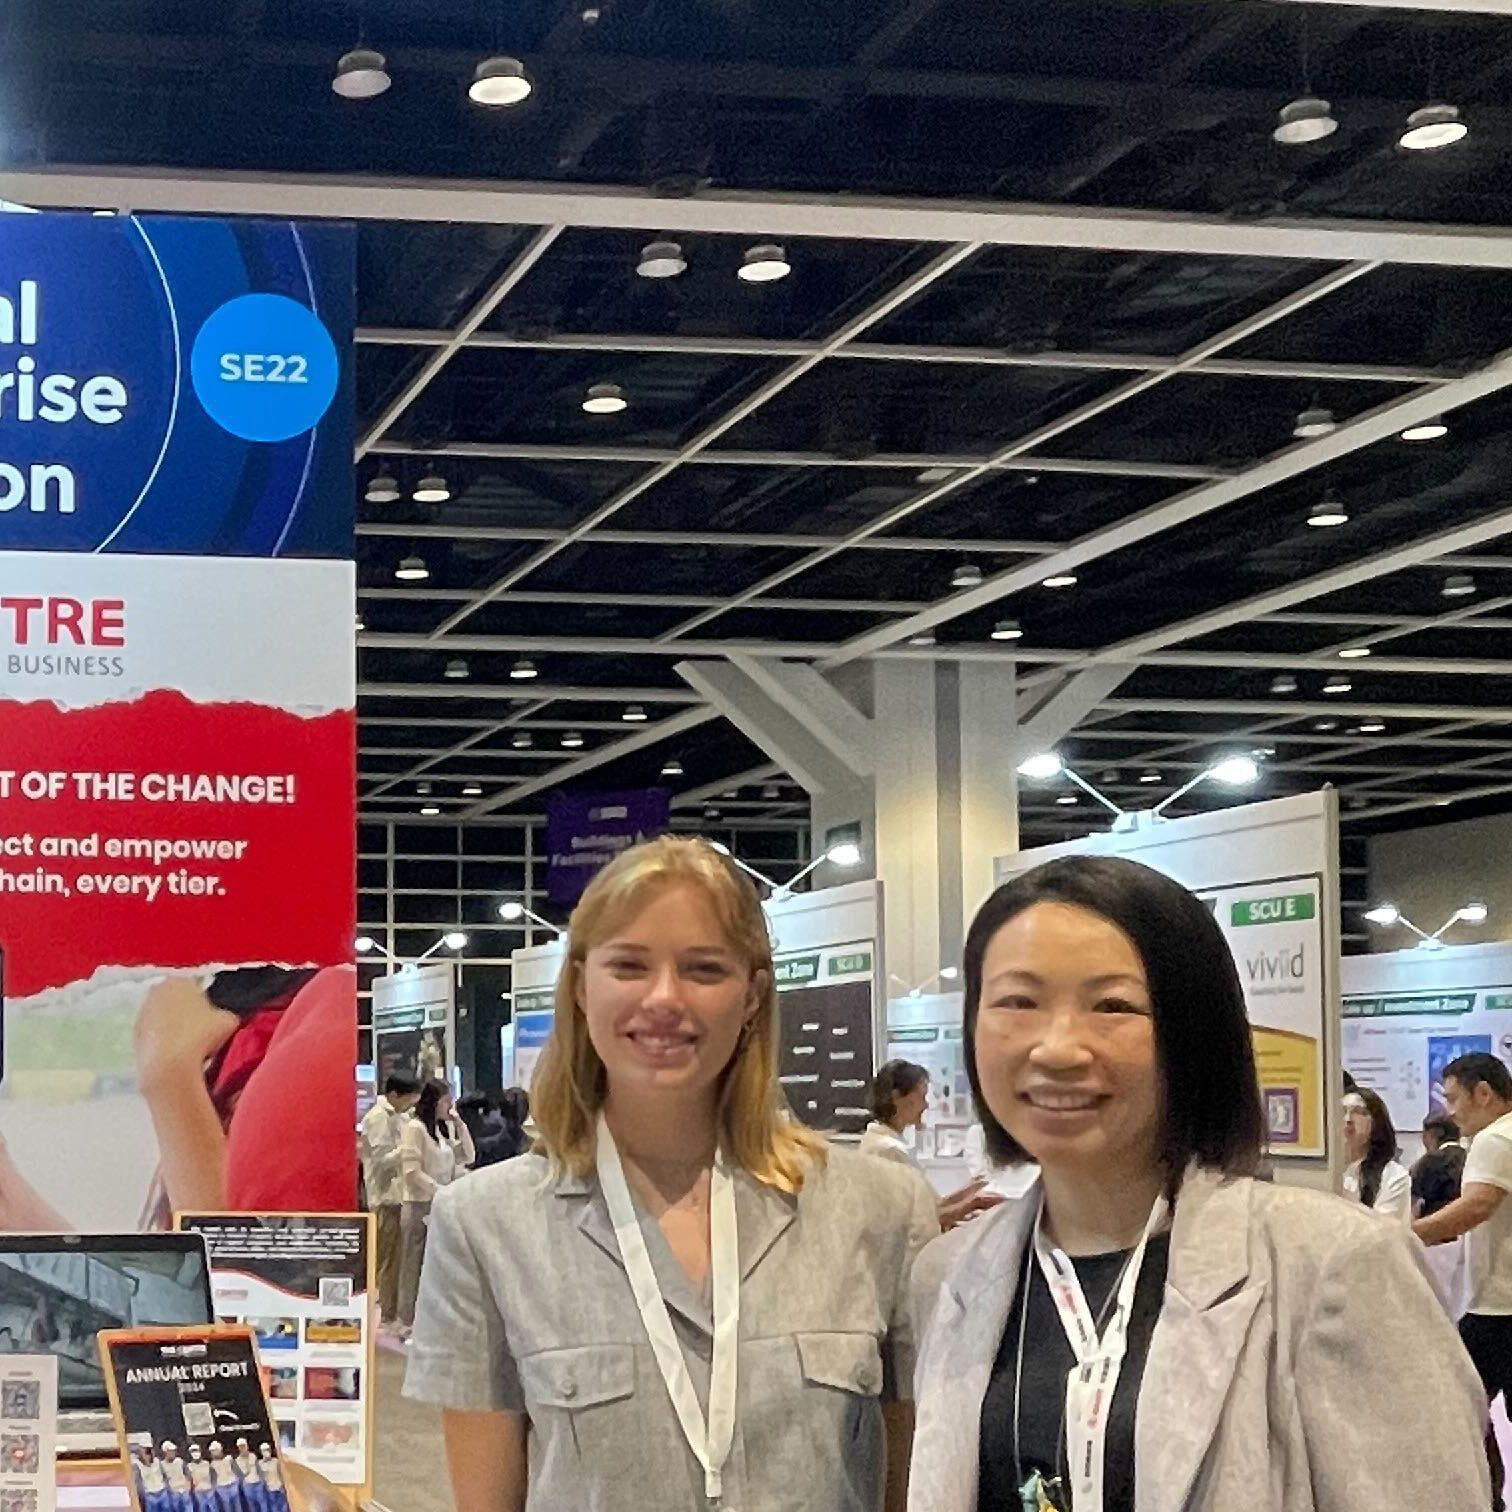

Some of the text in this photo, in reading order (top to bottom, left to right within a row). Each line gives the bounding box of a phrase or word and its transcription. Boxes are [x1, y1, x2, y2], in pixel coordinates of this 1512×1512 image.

[219, 353, 308, 384] SE22
[7, 654, 126, 678] BUSINESS
[20, 770, 68, 800] OF
[71, 772, 136, 801] THE
[140, 773, 295, 804] CHANGE!
[39, 832, 99, 858] and
[104, 838, 248, 866] empower
[76, 874, 162, 902] every
[166, 868, 226, 896] tier.
[1248, 899, 1296, 921] SCU E
[126, 1362, 248, 1384] ANNUAL REPORT
